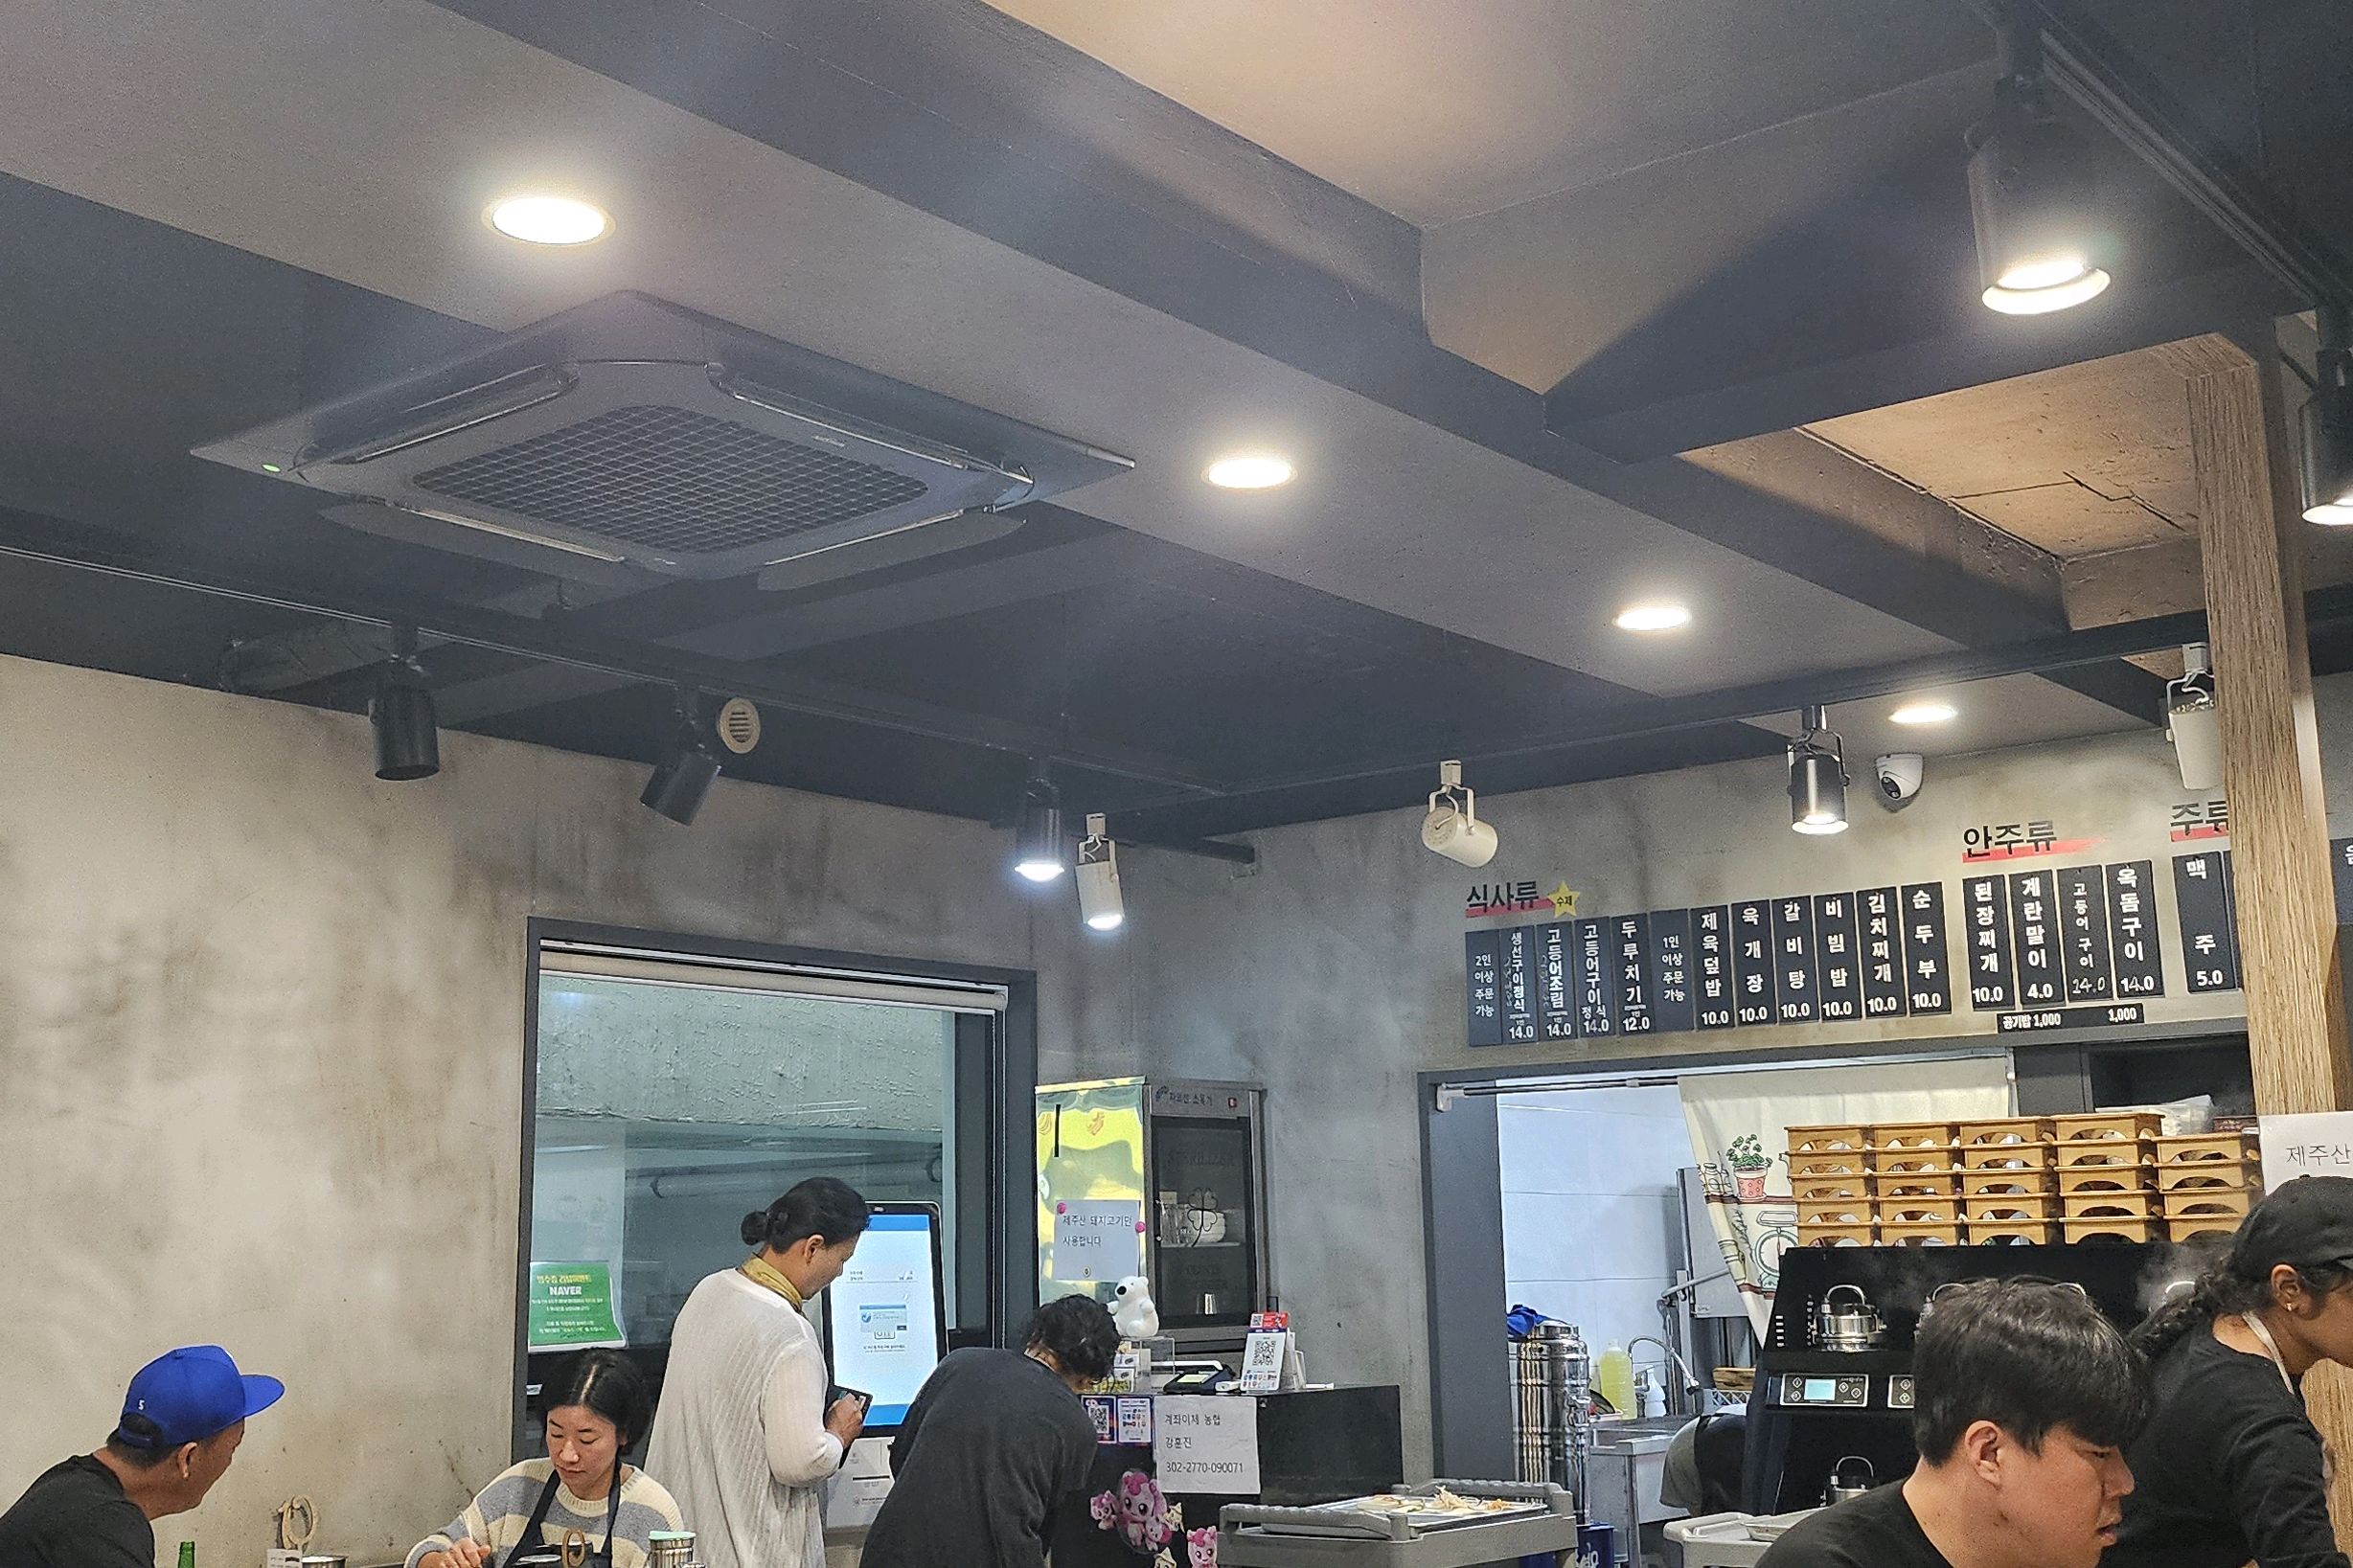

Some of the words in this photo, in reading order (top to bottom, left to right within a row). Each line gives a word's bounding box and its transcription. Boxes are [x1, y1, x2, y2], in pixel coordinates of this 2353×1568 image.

[1963, 820, 2058, 858] 안주류
[1466, 880, 1540, 913] 식사류
[2022, 876, 2047, 968] 계란말이
[2116, 868, 2144, 962] 옥돔구이
[1912, 889, 1937, 980] 순두부
[1974, 881, 1999, 973] 된장찌개
[1662, 935, 1679, 948] 1인
[1784, 902, 1806, 989] 갈비탕
[1825, 898, 1848, 988] 비빔밥
[1868, 894, 1893, 983] 김치찌개
[1702, 912, 1722, 997] 제육덮밥
[1741, 906, 1764, 993] 육개장
[1474, 953, 1492, 966] 2인
[1584, 924, 1602, 1006] 고등어구이
[1621, 920, 1642, 1004] 두루치기
[1661, 953, 1683, 966] 이상
[1474, 969, 1495, 984] 이상
[1511, 931, 1525, 1012] 생선구이정식
[1546, 928, 1564, 1009] 고등어조림
[1662, 970, 1684, 985] 주문
[2120, 975, 2155, 992] 14.0
[2196, 969, 2224, 987] 5.0
[1474, 987, 1495, 1001] 주문
[1663, 989, 1686, 1002] 가능
[1972, 986, 2004, 1003] 10.0
[2026, 983, 2054, 999] 4.0
[1822, 1001, 1853, 1017] 10.0
[1867, 996, 1898, 1012] 10.0
[1912, 992, 1942, 1009] 10.0
[1474, 1004, 1495, 1017] 가능
[1702, 1010, 1729, 1025] 10.0
[1739, 1006, 1768, 1022] 10.0
[1781, 1002, 1811, 1018] 10.0
[2002, 1014, 2032, 1030] 공기밥
[2033, 1012, 2062, 1028] 1,000
[2108, 1007, 2137, 1022] 1,000
[1508, 1025, 1534, 1039] 14.0
[1545, 1022, 1572, 1036] 14.0
[1583, 1018, 1610, 1033] 14.0
[1623, 1016, 1650, 1032] 12.0
[2285, 1143, 2351, 1167] 제주산
[549, 1285, 583, 1296] NAVER
[1166, 1461, 1244, 1473] 302-2770-090071
